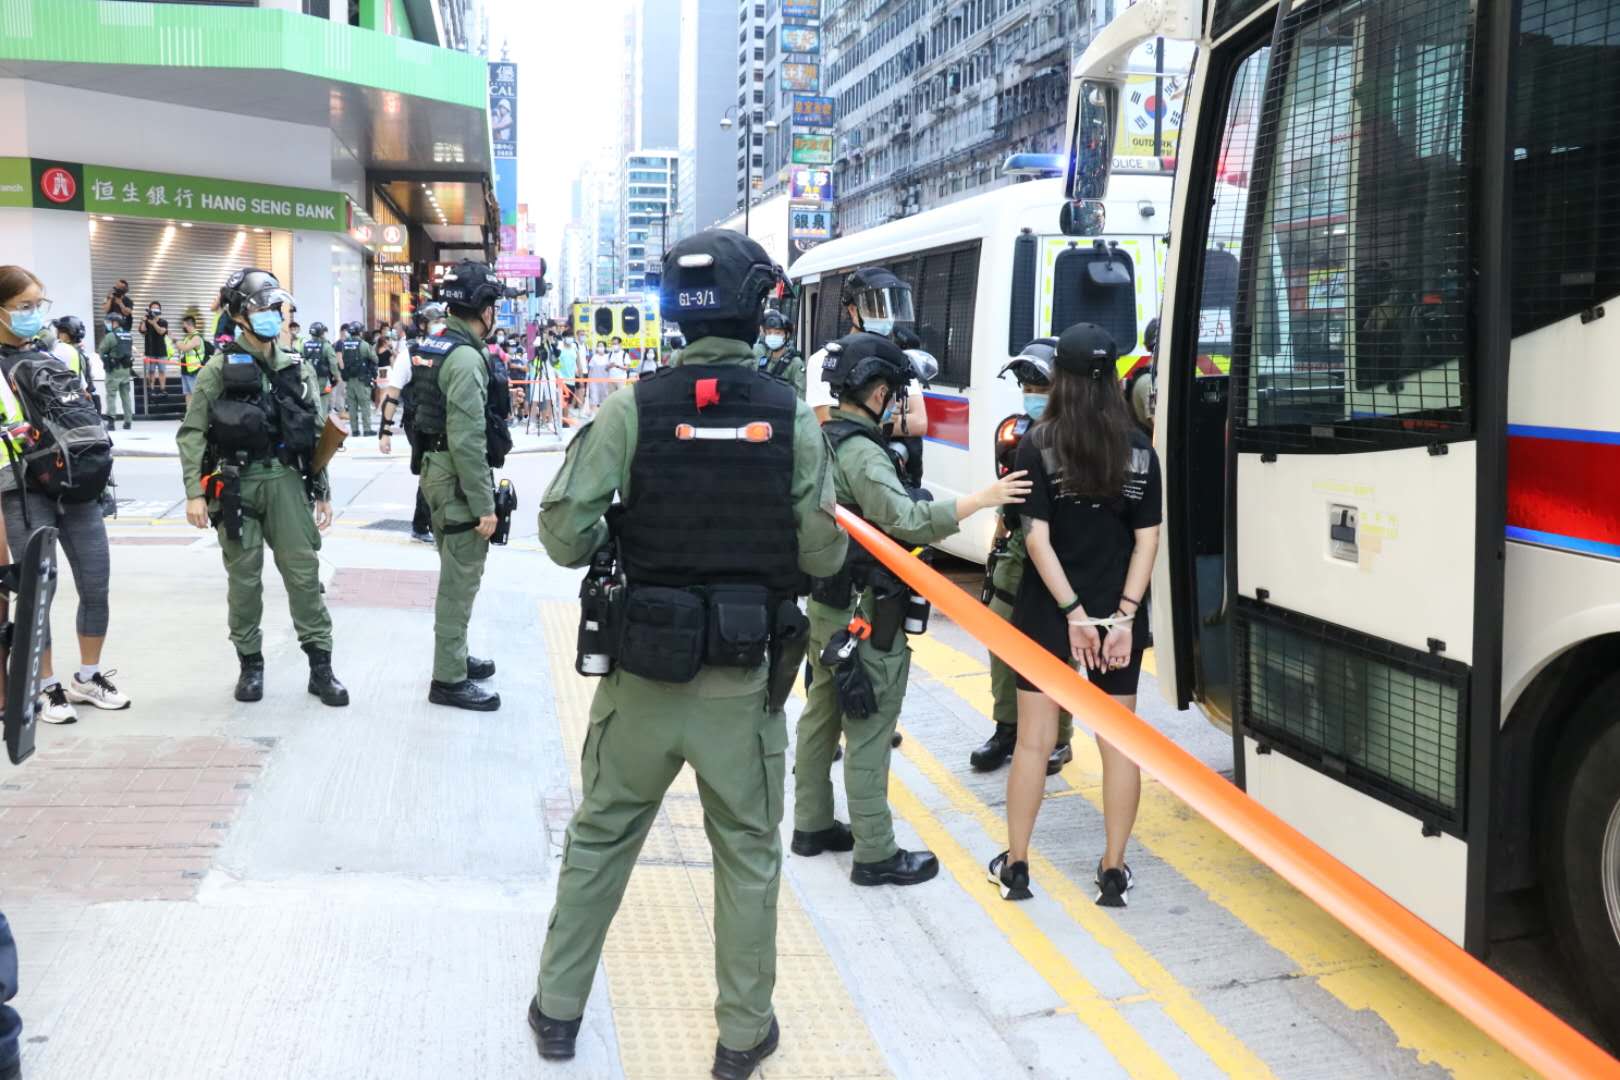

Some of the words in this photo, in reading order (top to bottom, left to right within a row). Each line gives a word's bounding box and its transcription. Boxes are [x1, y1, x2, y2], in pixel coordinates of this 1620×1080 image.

[1112, 158, 1143, 169] OLICE
[91, 177, 195, 209] 恒生銀行
[201, 192, 247, 212] HANG
[250, 199, 292, 216] SENG
[296, 202, 336, 221] BANK
[679, 289, 716, 307] G1-3/1
